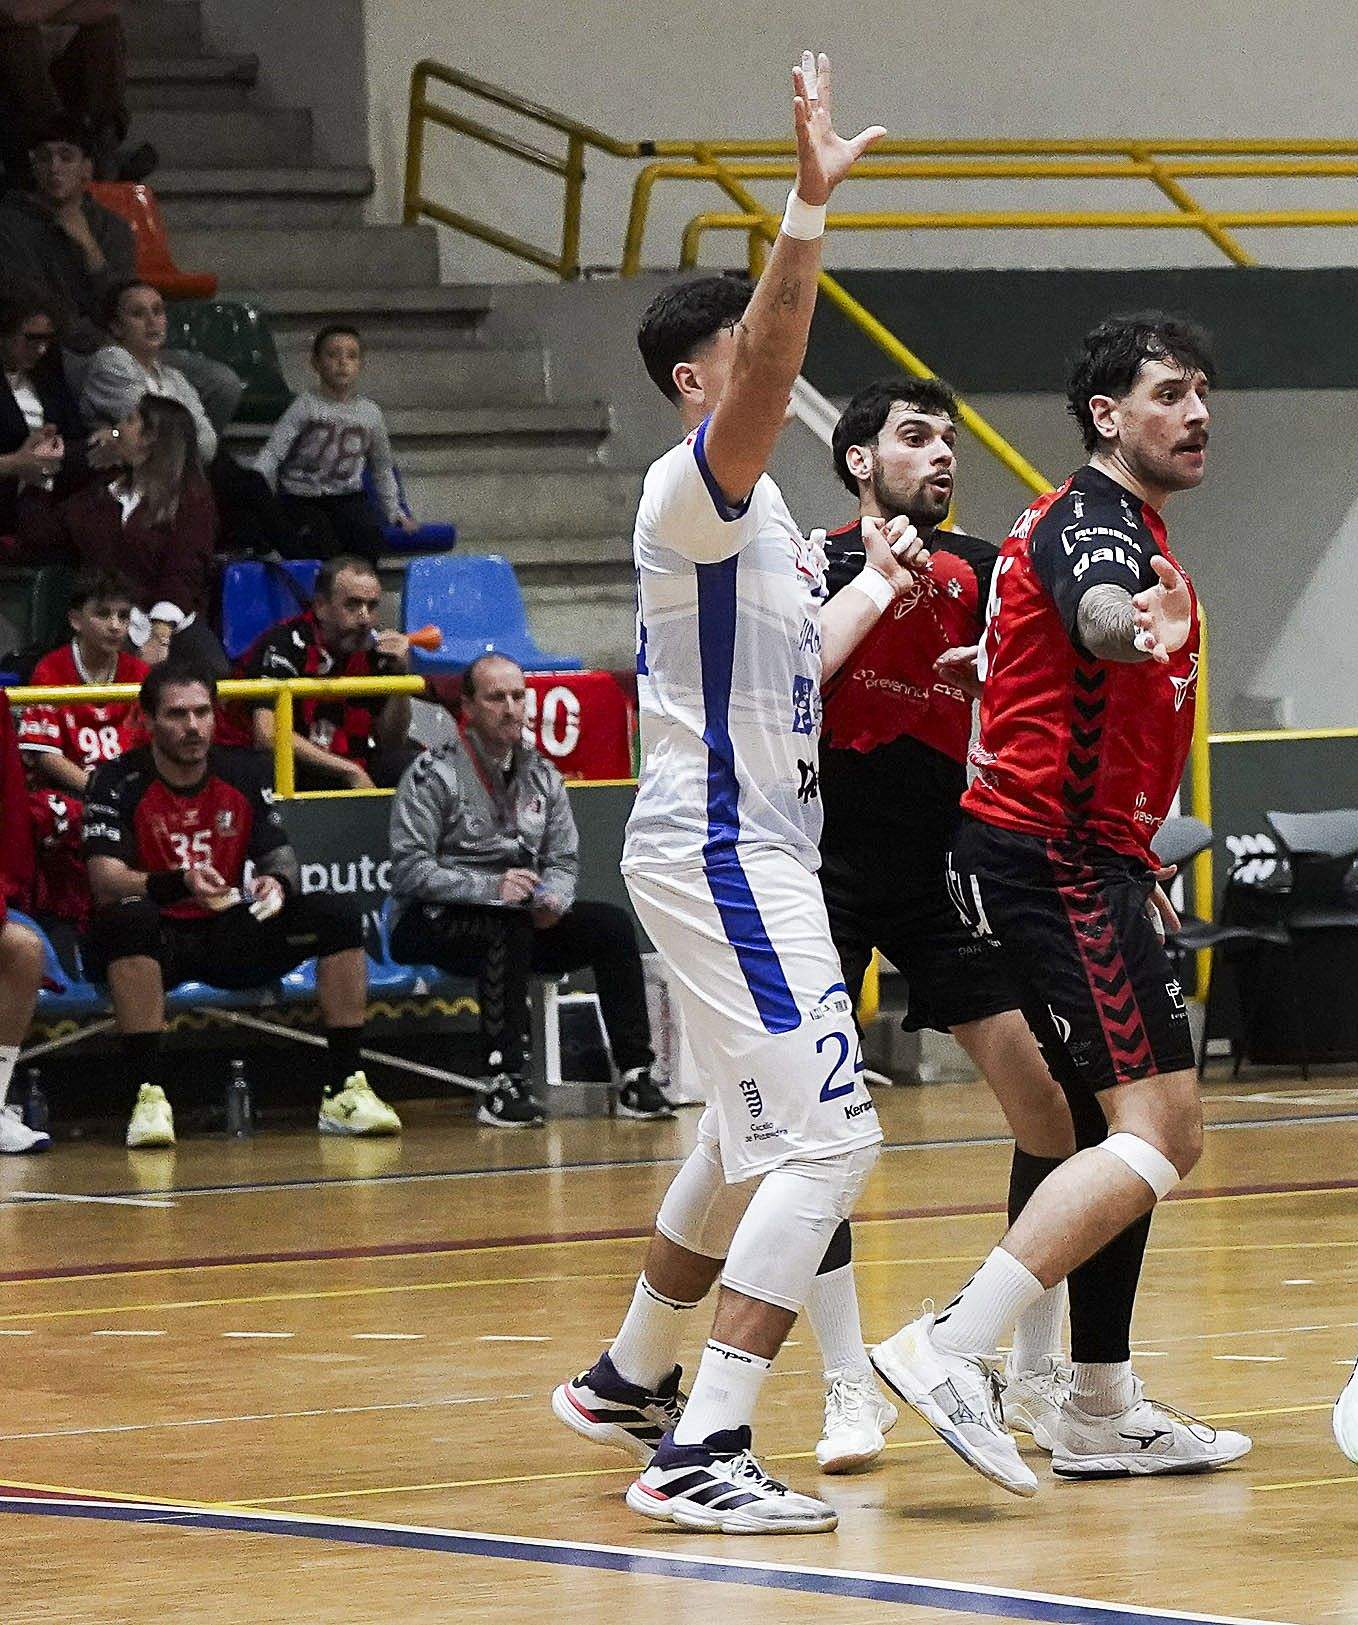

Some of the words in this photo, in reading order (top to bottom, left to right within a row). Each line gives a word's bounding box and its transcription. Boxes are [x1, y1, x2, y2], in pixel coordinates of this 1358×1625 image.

[1072, 546, 1140, 583] dala
[78, 726, 122, 764] 98
[170, 829, 213, 870] 35
